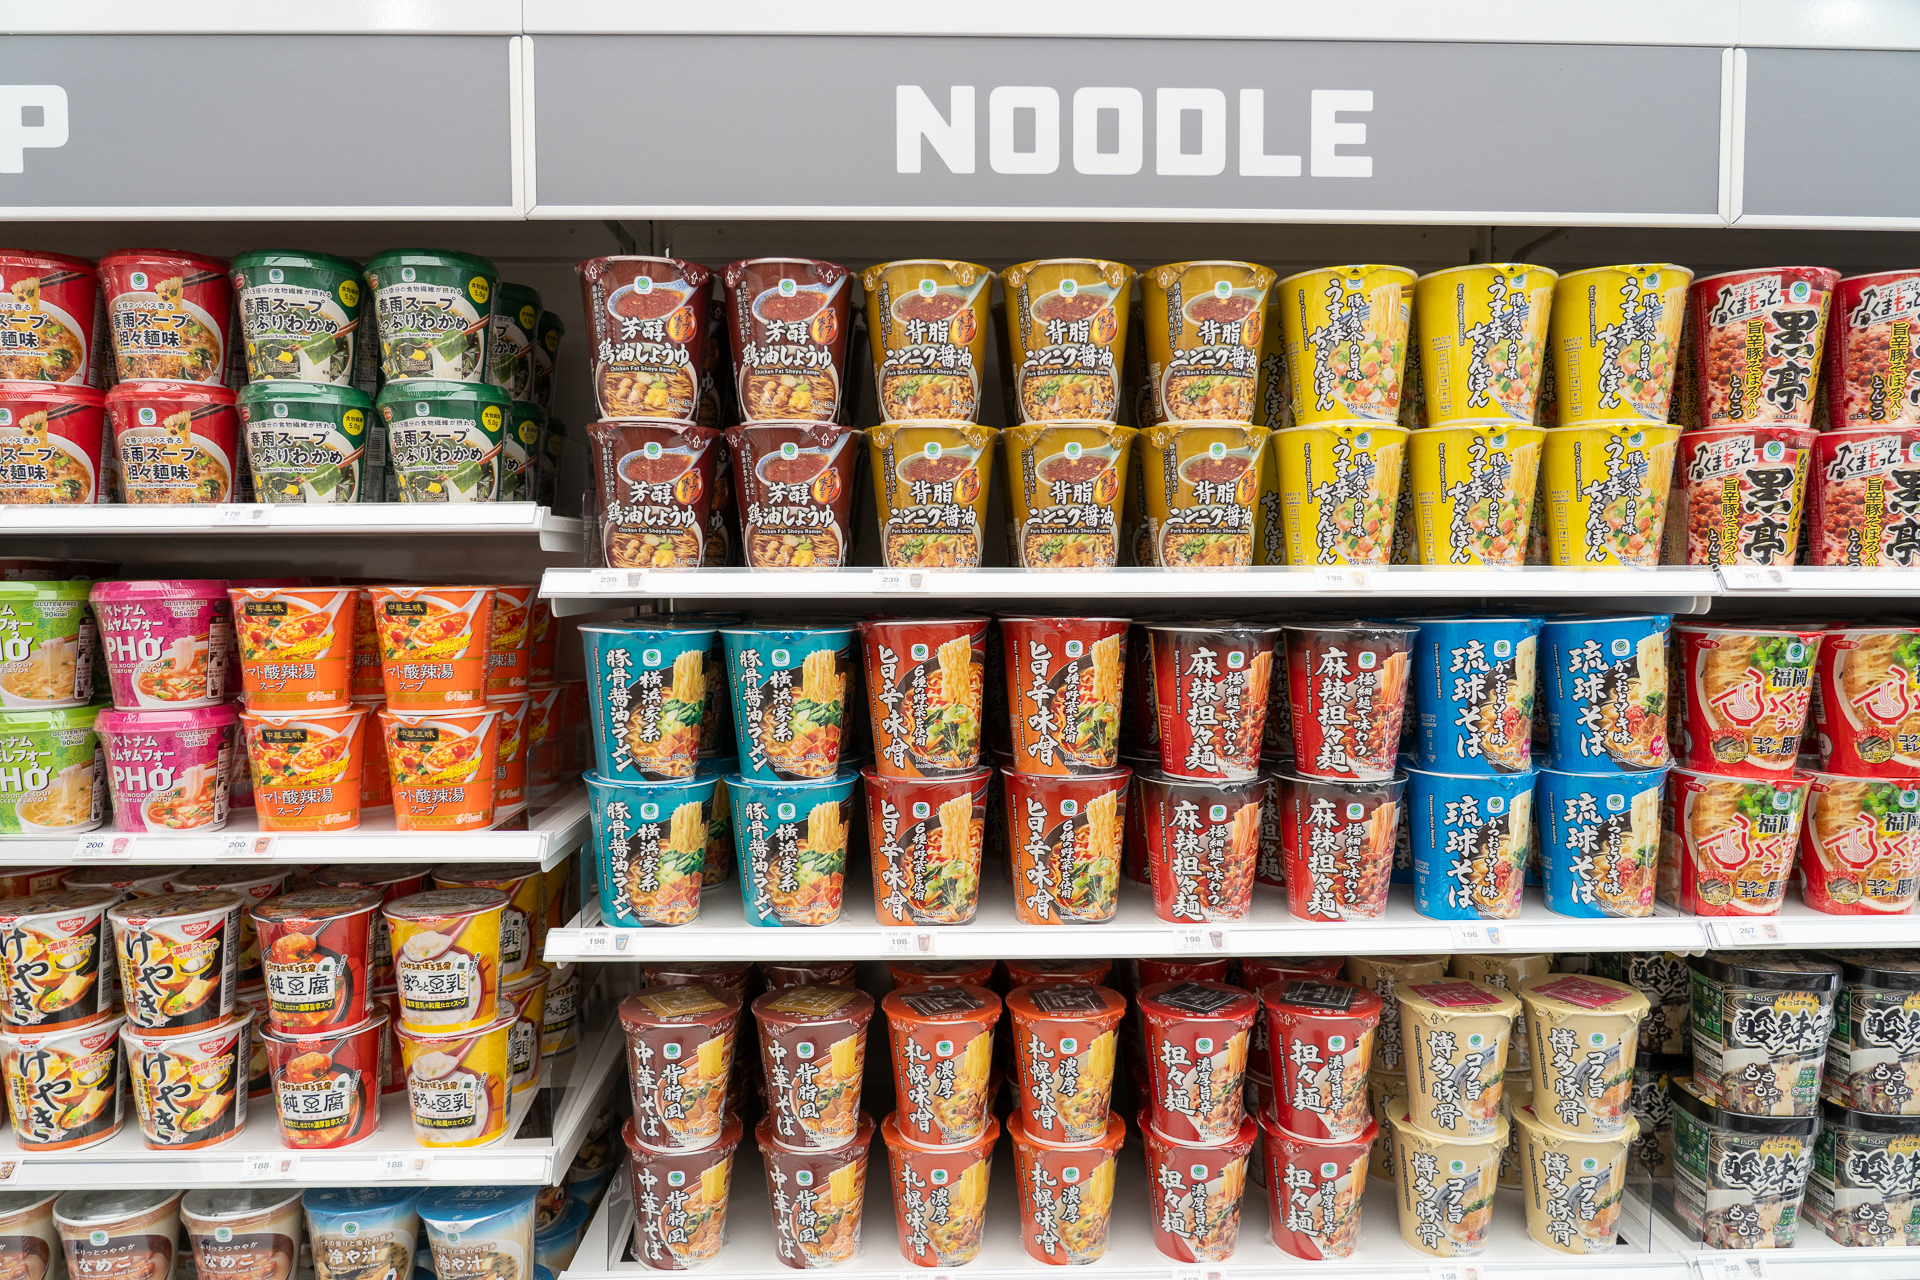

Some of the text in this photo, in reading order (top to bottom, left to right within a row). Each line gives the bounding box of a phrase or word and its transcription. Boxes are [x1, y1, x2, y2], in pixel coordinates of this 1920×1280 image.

[0, 85, 69, 173] P
[896, 85, 1373, 177] NOODLE
[113, 311, 190, 329] 春雨スープ
[244, 296, 325, 314] 春雨スープ
[344, 293, 356, 302] 5.0g
[379, 296, 456, 315] 春雨スープ
[620, 317, 666, 340] 芳醇
[1325, 277, 1350, 345] うま辛
[1487, 276, 1509, 345] うま辛
[1619, 277, 1641, 345] うま辛
[119, 330, 181, 347] 担々麺味
[598, 339, 690, 365] 鶏油しょうゆ
[743, 341, 832, 369] 鶏油しょうゆ
[766, 321, 810, 345] 芳醇
[884, 344, 973, 368] ニンニク醤油
[905, 319, 949, 345] 背脂
[1024, 344, 1114, 368] ニンニク醤油
[1044, 319, 1090, 345] 背脂
[1171, 344, 1259, 370] ニンニク醤油
[1198, 320, 1240, 345] 背脂
[1344, 293, 1365, 381] 豚と魚介の旨味
[1766, 309, 1818, 413] 黒亭
[1310, 325, 1335, 410] ちゃんぽん
[1465, 325, 1488, 409] ちゃんぽん
[1597, 324, 1620, 409] ちゃんぽん
[1728, 375, 1744, 420] とんこつ
[1745, 321, 1765, 418] 旨辛豚そぼろ入り
[1869, 375, 1886, 420] とんこつ
[1888, 322, 1910, 419] 旨辛豚そぼろ入り
[121, 446, 198, 463] 春雨スープ
[251, 431, 330, 447] 春雨スープ
[393, 428, 470, 447] 春雨スープ
[1332, 437, 1353, 501] うま辛
[1468, 437, 1491, 502] うま辛
[1604, 437, 1626, 501] うま辛
[128, 465, 191, 481] 担々麺味
[629, 481, 674, 505] 芳醇
[768, 481, 812, 505] 芳醇
[910, 480, 953, 505] 背脂
[1050, 480, 1094, 505] 背脂
[1192, 480, 1235, 505] 背脂
[607, 500, 696, 528] 鶏油しょうゆ
[747, 503, 835, 528] 鶏油しょうゆ
[888, 507, 976, 528] ニンニク醤油
[1028, 506, 1115, 528] ニンニク醤油
[1167, 506, 1254, 528] ニンニク醤油
[1313, 481, 1338, 565] ちゃんぽん
[1447, 481, 1472, 564] ちゃんぽん
[1583, 479, 1608, 563] ちゃんぽん
[1743, 467, 1795, 566] 黒亭
[103, 619, 164, 632] トムヤムフォー
[104, 604, 147, 616] ベトナム
[243, 664, 315, 680] トマト酸辣湯
[307, 691, 336, 701] 64kcal
[383, 664, 454, 679] トマト酸辣湯
[1450, 640, 1490, 758] 琉球そば
[1490, 660, 1511, 746] かつおとソーキ味
[1569, 640, 1608, 757] 琉球そば
[1771, 667, 1808, 688] 福岡
[605, 648, 634, 773] 豚骨醤油ラーメン
[639, 670, 664, 742] 横浜家系
[739, 649, 769, 773] 豚骨醤油ラーメン
[769, 670, 793, 743] 横浜家系
[877, 644, 911, 770] 旨辛味噌
[911, 665, 928, 747] 6種の野菜を使用
[1026, 640, 1059, 768] 旨辛味噌
[1184, 646, 1222, 774] 麻辣担々麺
[1223, 671, 1244, 756] 極細麺で味わう
[1314, 646, 1353, 773] 麻辣担々麺
[1353, 671, 1375, 756] 極細麺で味わう
[109, 750, 175, 762] トムヤムフォー
[113, 735, 158, 747] ベトナム
[258, 788, 333, 804] トマト酸辣湯
[393, 788, 465, 804] トマト酸辣湯
[1756, 813, 1794, 834] 福岡
[606, 802, 633, 921] 豚骨醤油ラーメン
[745, 802, 774, 921] 豚骨醤油ラーメン
[879, 798, 909, 921] 旨辛味噌
[1024, 797, 1055, 920] 旨辛味噌
[1168, 798, 1205, 922] 麻辣担々麺
[1304, 798, 1341, 920] 麻辣担々麺
[1443, 794, 1483, 909] 琉球そば
[1563, 792, 1603, 905] 琉球そば
[59, 919, 84, 929] NISSIN
[0, 928, 49, 1025] けやき
[126, 932, 174, 1028] けやき
[269, 974, 329, 995] 純豆腐
[403, 973, 465, 993] まろっと豆乳
[1754, 994, 1773, 1002] ISDG
[19, 1050, 71, 1142] けやき
[143, 1053, 192, 1143] けやき
[283, 1091, 345, 1113] 純豆腐
[413, 1093, 473, 1112] まろっと豆乳
[633, 1039, 661, 1137] 中華そば
[661, 1063, 686, 1120] 背脂風
[767, 1039, 796, 1137] 中華そば
[904, 1036, 934, 1134] 札幌味噌
[934, 1059, 956, 1100] 濃厚
[1027, 1033, 1058, 1132] 札幌味噌
[1160, 1039, 1197, 1117] 担々麺
[1194, 1056, 1214, 1117] 濃厚旨辛
[1289, 1038, 1327, 1114] 担々麺
[1427, 1031, 1462, 1130] 博多豚骨
[1464, 1051, 1485, 1101] コク旨
[1549, 1027, 1586, 1127] 博多豚骨
[1739, 1063, 1775, 1082] もち
[1754, 1081, 1782, 1097] もち
[638, 1167, 664, 1261] 中華そば
[770, 1165, 796, 1260] 中華そば
[901, 1163, 929, 1257] 札幌味噌
[1030, 1162, 1061, 1255] 札幌味噌
[1157, 1162, 1192, 1240] 担々麺
[1283, 1162, 1320, 1237] 担々麺
[1410, 1151, 1445, 1250] 博多豚骨
[1542, 1152, 1578, 1247] 博多豚骨
[78, 1256, 132, 1272] なめこ
[204, 1252, 255, 1268] なめこ
[328, 1246, 379, 1264] 冷や汁
[439, 1255, 483, 1271] 冷や汁
